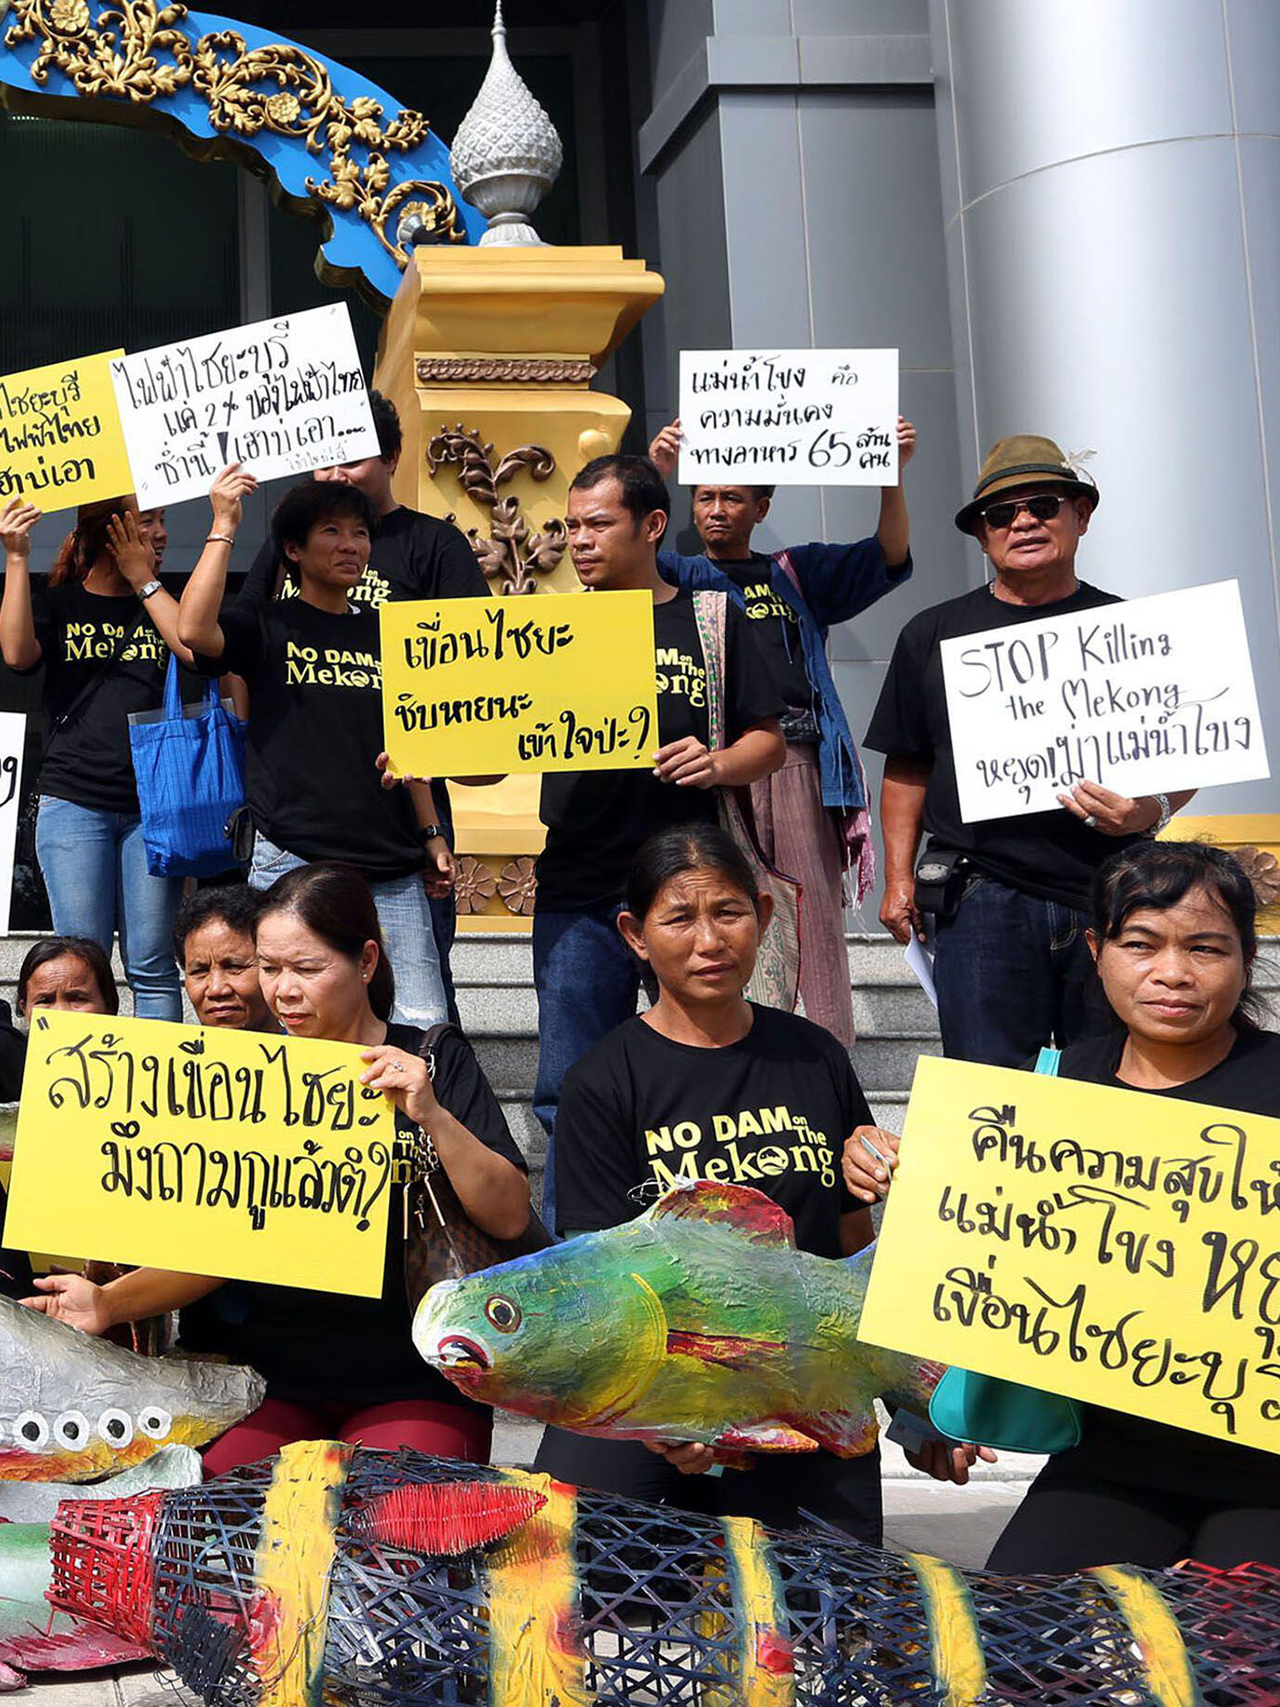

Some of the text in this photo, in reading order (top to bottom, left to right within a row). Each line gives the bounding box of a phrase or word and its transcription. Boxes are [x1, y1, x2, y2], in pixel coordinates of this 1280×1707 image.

[808, 428, 852, 467] 65
[66, 622, 96, 639] NO
[287, 641, 374, 667] NO DAM
[958, 623, 1172, 698] STOP Killing
[1005, 677, 1183, 721] the Mekong
[398, 1130, 415, 1139] on
[644, 1106, 792, 1156] NO DAM
[792, 1116, 807, 1126] on
[792, 1126, 827, 1146] The
[648, 1142, 836, 1197] Mekong
